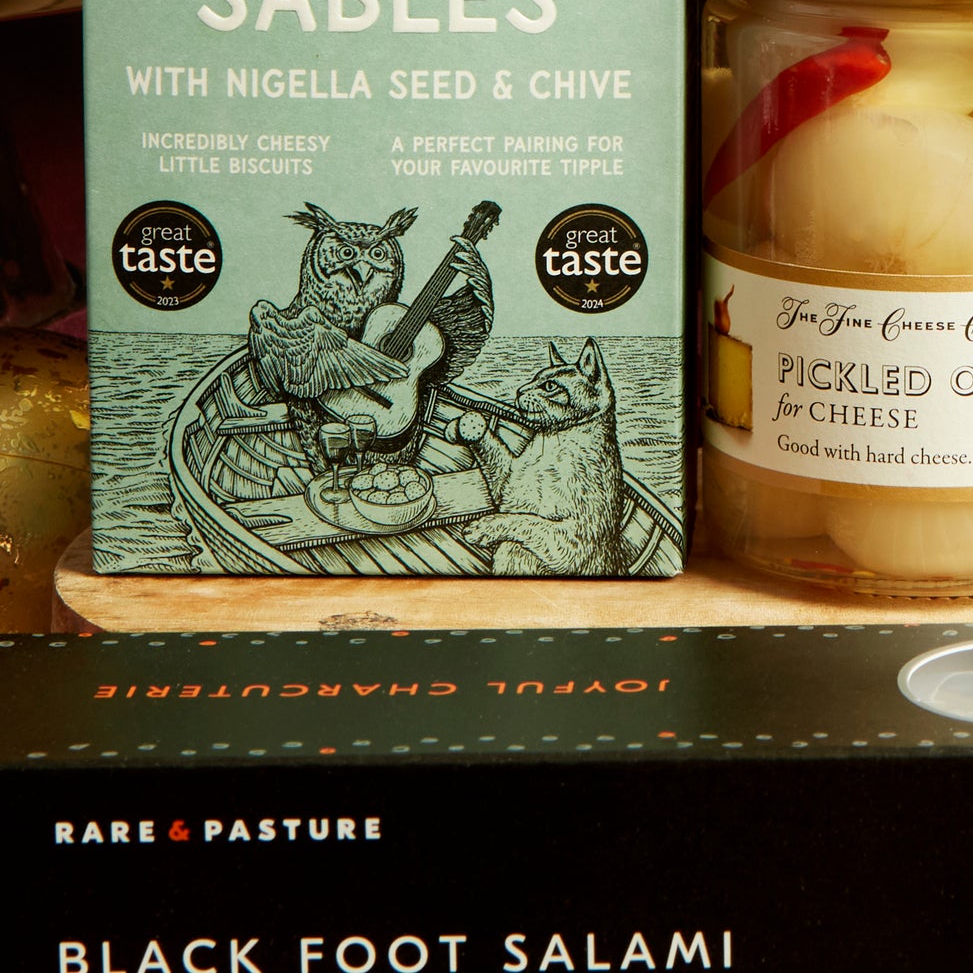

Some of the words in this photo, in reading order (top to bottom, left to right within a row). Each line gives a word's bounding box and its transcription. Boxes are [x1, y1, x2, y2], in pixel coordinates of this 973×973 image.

[126, 66, 208, 99] WITH
[227, 67, 372, 100] NIGELLA
[389, 69, 477, 100] SEED
[492, 71, 514, 100] &
[530, 69, 632, 100] CHIVE
[142, 132, 249, 153] INCREDIBLY
[257, 133, 331, 153] CHEESY
[391, 135, 404, 153] A
[413, 136, 496, 154] PERFECT
[504, 136, 579, 153] PAIRING
[588, 135, 624, 153] FOR
[159, 155, 220, 175] LITTLE
[229, 157, 312, 176] BISCUITS
[391, 158, 443, 176] YOUR
[451, 159, 552, 177] FAVOURITE
[560, 159, 624, 176] TIPPLE
[140, 224, 192, 246] great
[565, 227, 618, 249] great
[118, 242, 216, 274] taste
[542, 246, 642, 276] taste
[156, 296, 180, 306] 2023
[581, 298, 604, 309] 2024
[777, 352, 932, 397] PICKLED
[772, 392, 803, 422] for
[809, 401, 919, 429] CHEESE
[777, 434, 819, 457] Good
[824, 444, 861, 462] with
[866, 445, 906, 464] hard
[910, 447, 972, 465] cheese.
[95, 683, 456, 697] CHARCUTERIE
[488, 680, 669, 694] JOYFUL
[55, 821, 155, 844] RARE
[169, 820, 189, 841] &
[205, 817, 380, 841] PASTURE
[59, 940, 262, 973] BLACK
[301, 935, 467, 973] FOOT
[503, 931, 732, 972] SALAMI
